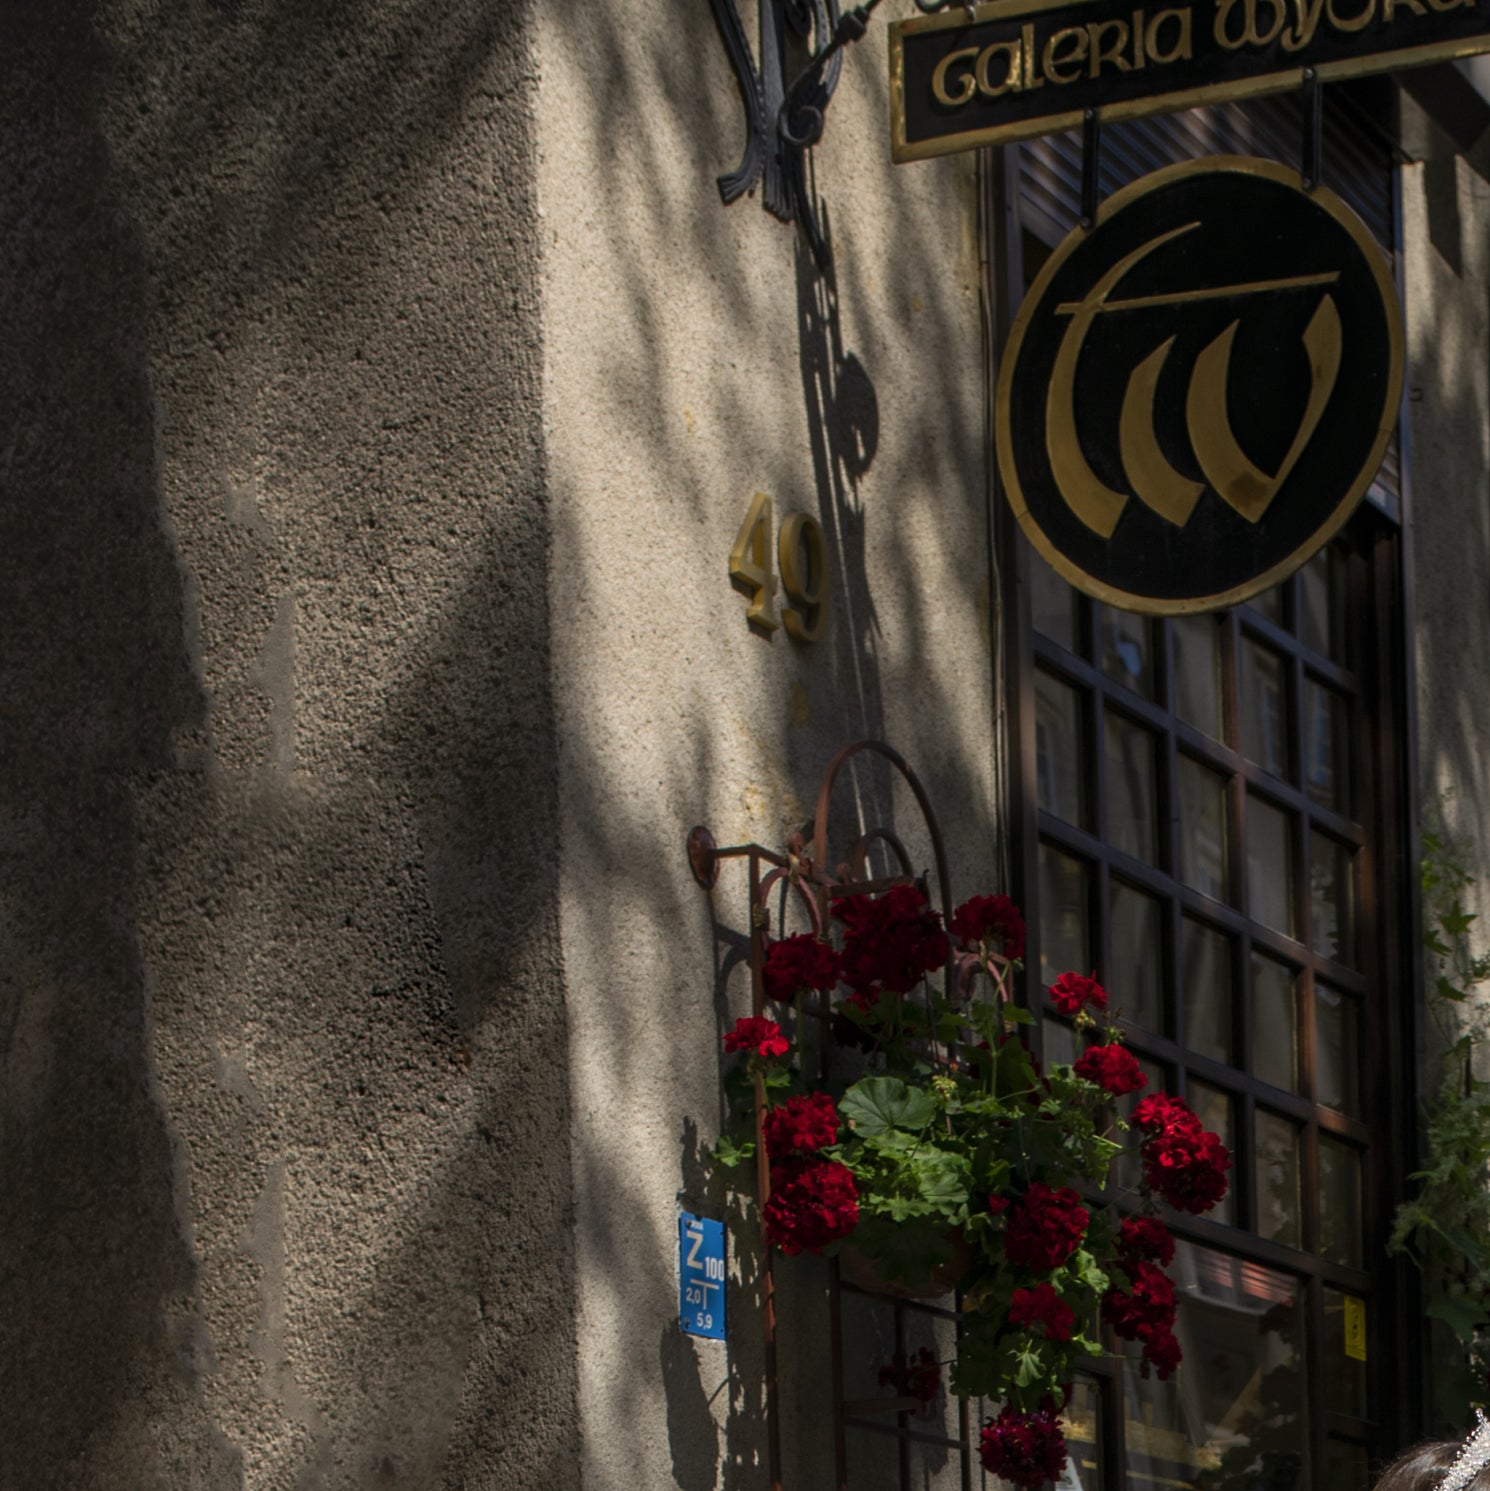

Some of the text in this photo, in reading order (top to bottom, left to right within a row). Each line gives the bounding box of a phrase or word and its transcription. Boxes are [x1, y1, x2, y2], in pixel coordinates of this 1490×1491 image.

[729, 492, 831, 645] 49
[686, 1230, 725, 1281] Z 100
[685, 1287, 701, 1304] 2,0
[696, 1312, 713, 1330] 5,9
